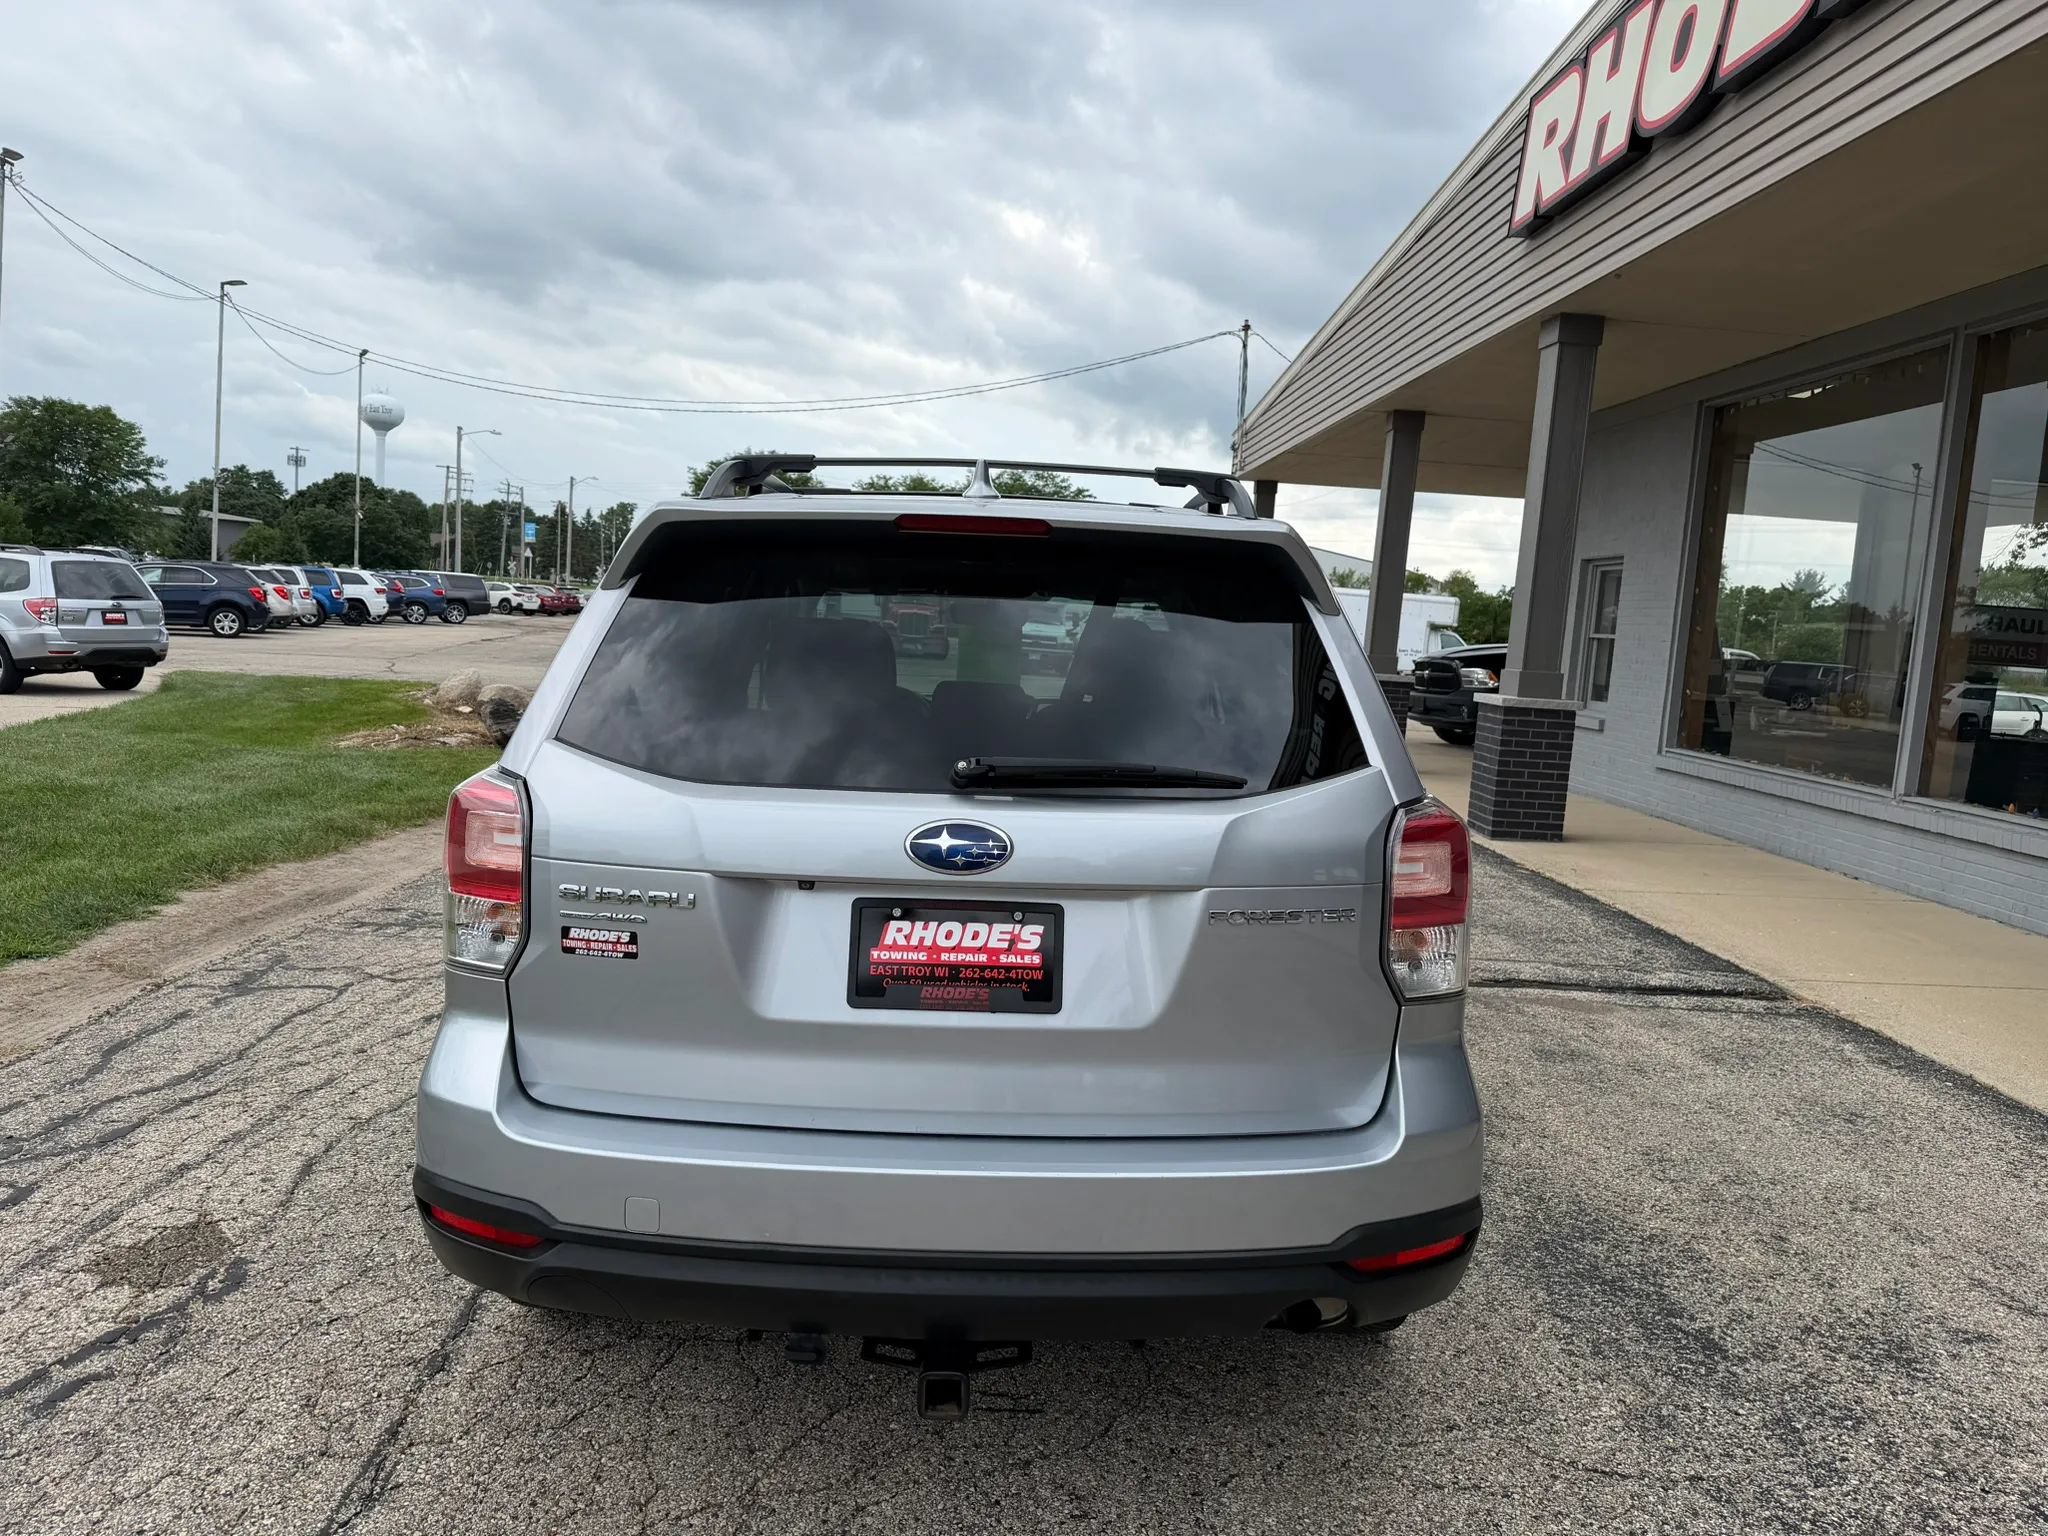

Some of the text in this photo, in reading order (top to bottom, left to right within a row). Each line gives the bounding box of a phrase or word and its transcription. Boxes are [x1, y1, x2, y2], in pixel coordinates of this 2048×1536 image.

[558, 883, 696, 910] SUBARU
[1208, 908, 1355, 924] FORESTER
[569, 928, 630, 942] RHODE'S
[883, 920, 1044, 950] RHODE'S
[562, 938, 637, 953] TOWING REPAIR SALES
[575, 949, 624, 958] 262-642-4TOW
[871, 951, 1041, 965] TOWING REPAIR SALES
[869, 965, 1044, 980] EAST TROY WI 262-642-4TOW
[920, 987, 990, 999] RHODE'S
